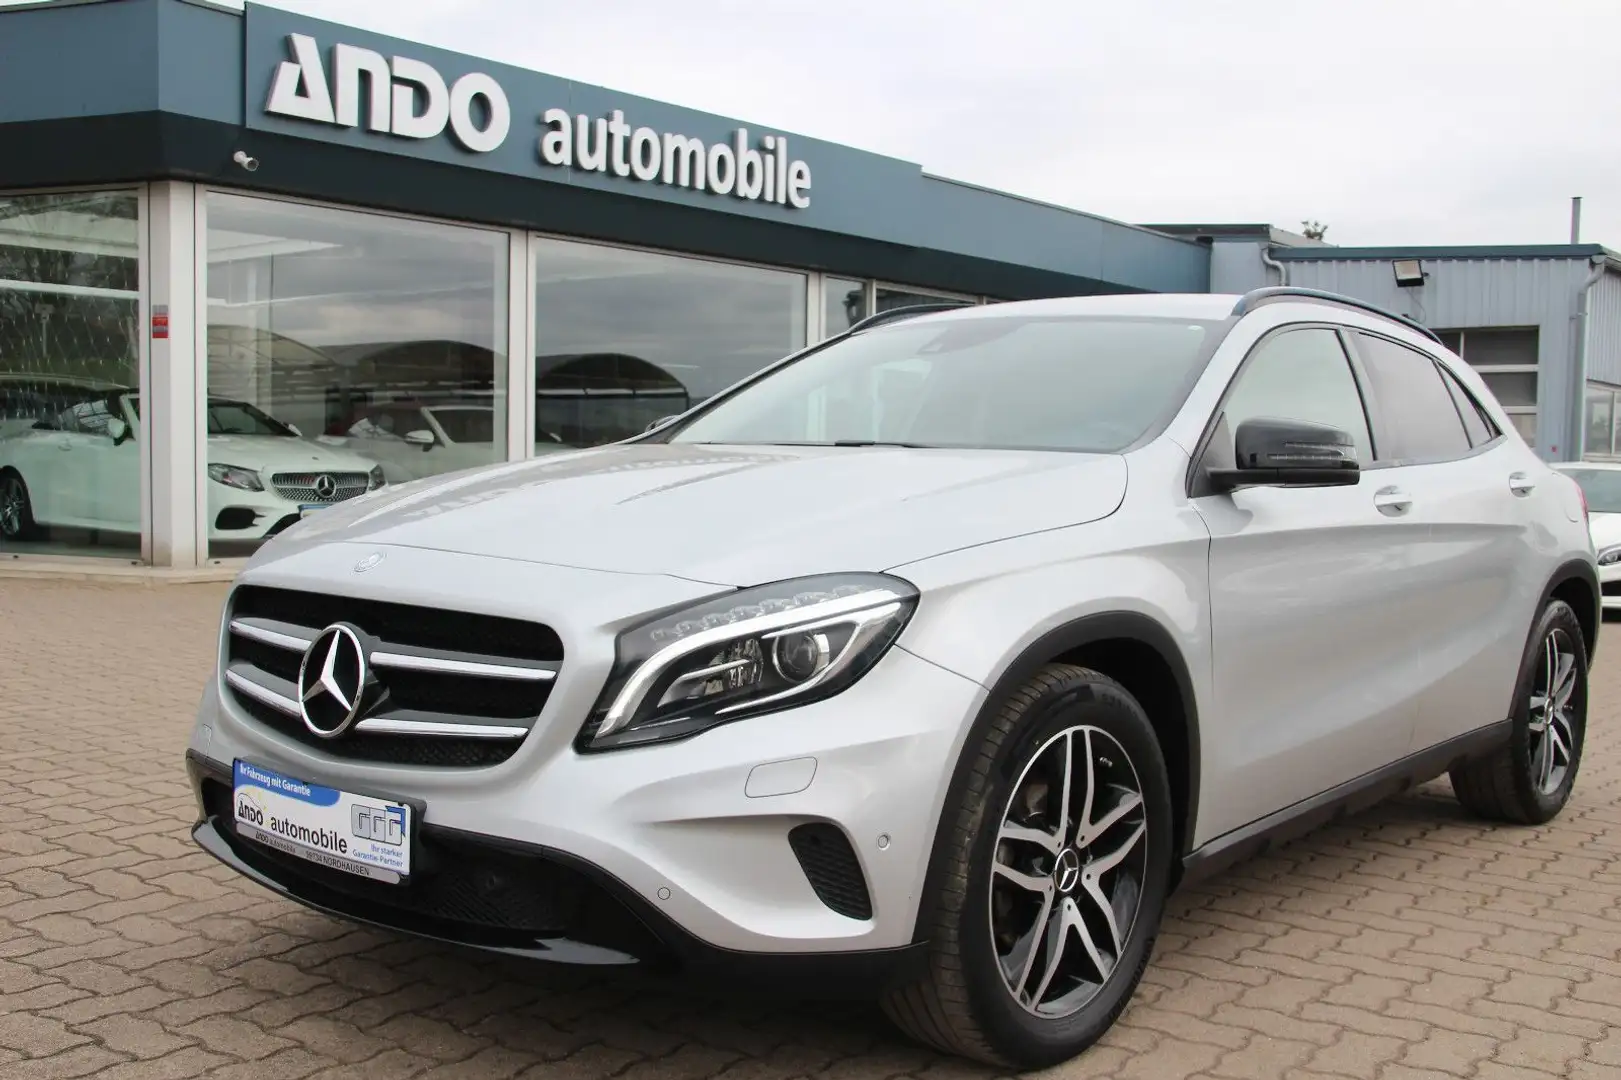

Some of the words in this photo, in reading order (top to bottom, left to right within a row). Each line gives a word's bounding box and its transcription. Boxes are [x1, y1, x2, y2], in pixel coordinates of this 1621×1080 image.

[265, 32, 511, 153] ANDO
[540, 105, 812, 210] automobile
[247, 766, 271, 786] Fahrzeug
[271, 777, 282, 789] mit
[282, 779, 311, 797] Garantie
[238, 800, 264, 826] ANDO
[270, 816, 348, 854] automobile
[323, 856, 370, 876] NORDHAUSEN
[370, 843, 380, 853] Ihr
[380, 845, 403, 858] starker
